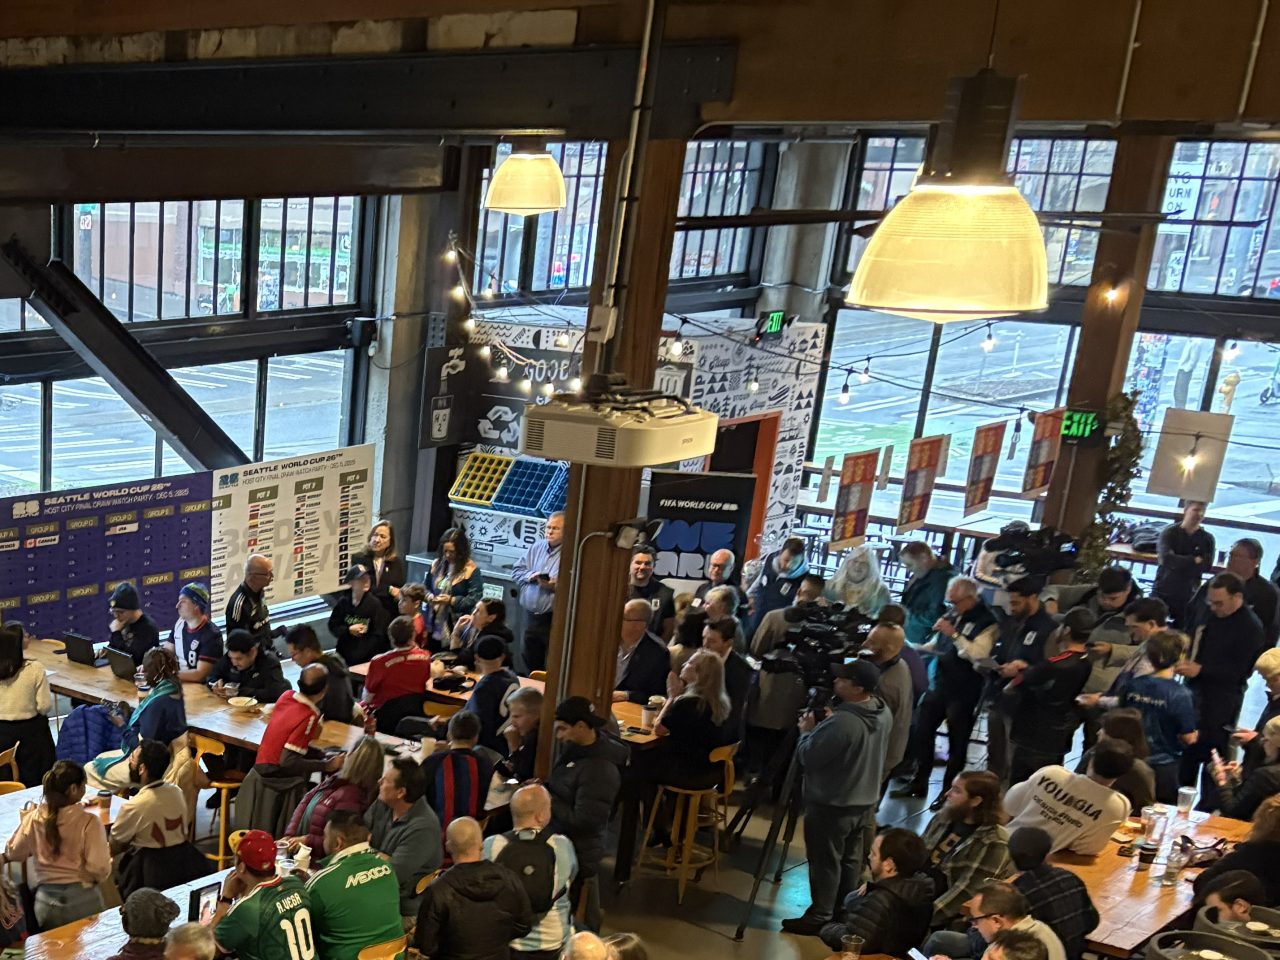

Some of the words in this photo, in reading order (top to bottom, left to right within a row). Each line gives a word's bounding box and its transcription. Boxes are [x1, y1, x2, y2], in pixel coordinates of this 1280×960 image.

[1168, 187, 1192, 198] URN
[766, 312, 784, 333] EXIT
[552, 330, 576, 338] STOP
[243, 465, 278, 477] SEATTLE
[281, 459, 308, 470] WORLD
[309, 456, 326, 466] CUP
[793, 441, 805, 482] STOUP
[44, 493, 91, 506] SEATTLE
[92, 488, 129, 499] WORLD
[129, 485, 150, 493] CUP
[660, 499, 677, 508] FIFA
[677, 500, 705, 509] WORLD
[705, 501, 722, 510] CUP
[44, 506, 60, 516] HOST
[60, 504, 75, 512] CITY
[30, 525, 49, 534] GROUP
[654, 551, 711, 578] AR
[188, 650, 197, 667] 8
[345, 864, 391, 888] MEXICO
